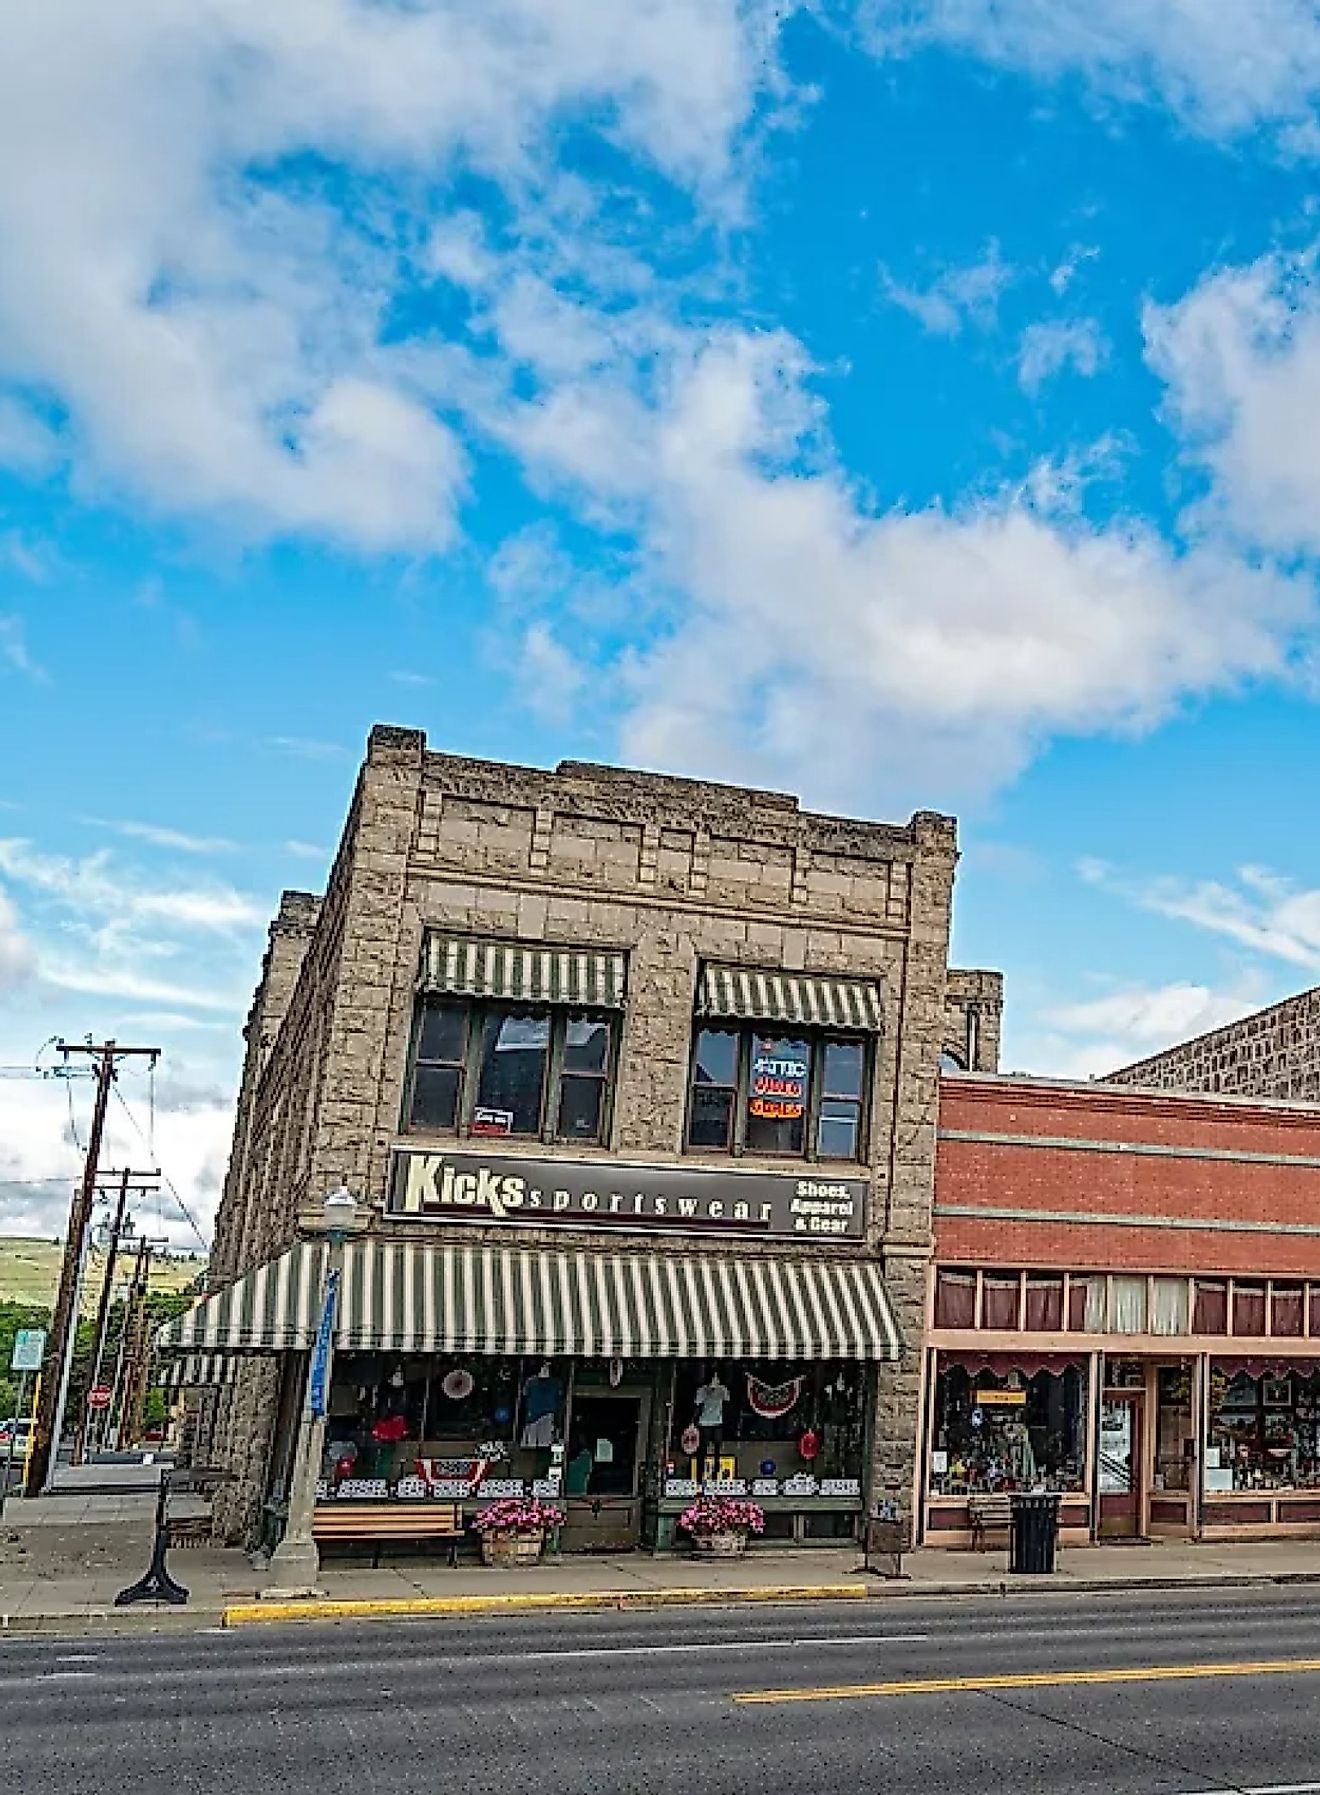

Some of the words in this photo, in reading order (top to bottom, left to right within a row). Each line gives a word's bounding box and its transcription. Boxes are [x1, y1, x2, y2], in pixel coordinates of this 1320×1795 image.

[405, 1155, 525, 1216] Kicks
[530, 1188, 772, 1220] sportswear
[791, 1199, 853, 1216] Apparel
[796, 1216, 807, 1230] &
[811, 1217, 848, 1232] Gear
